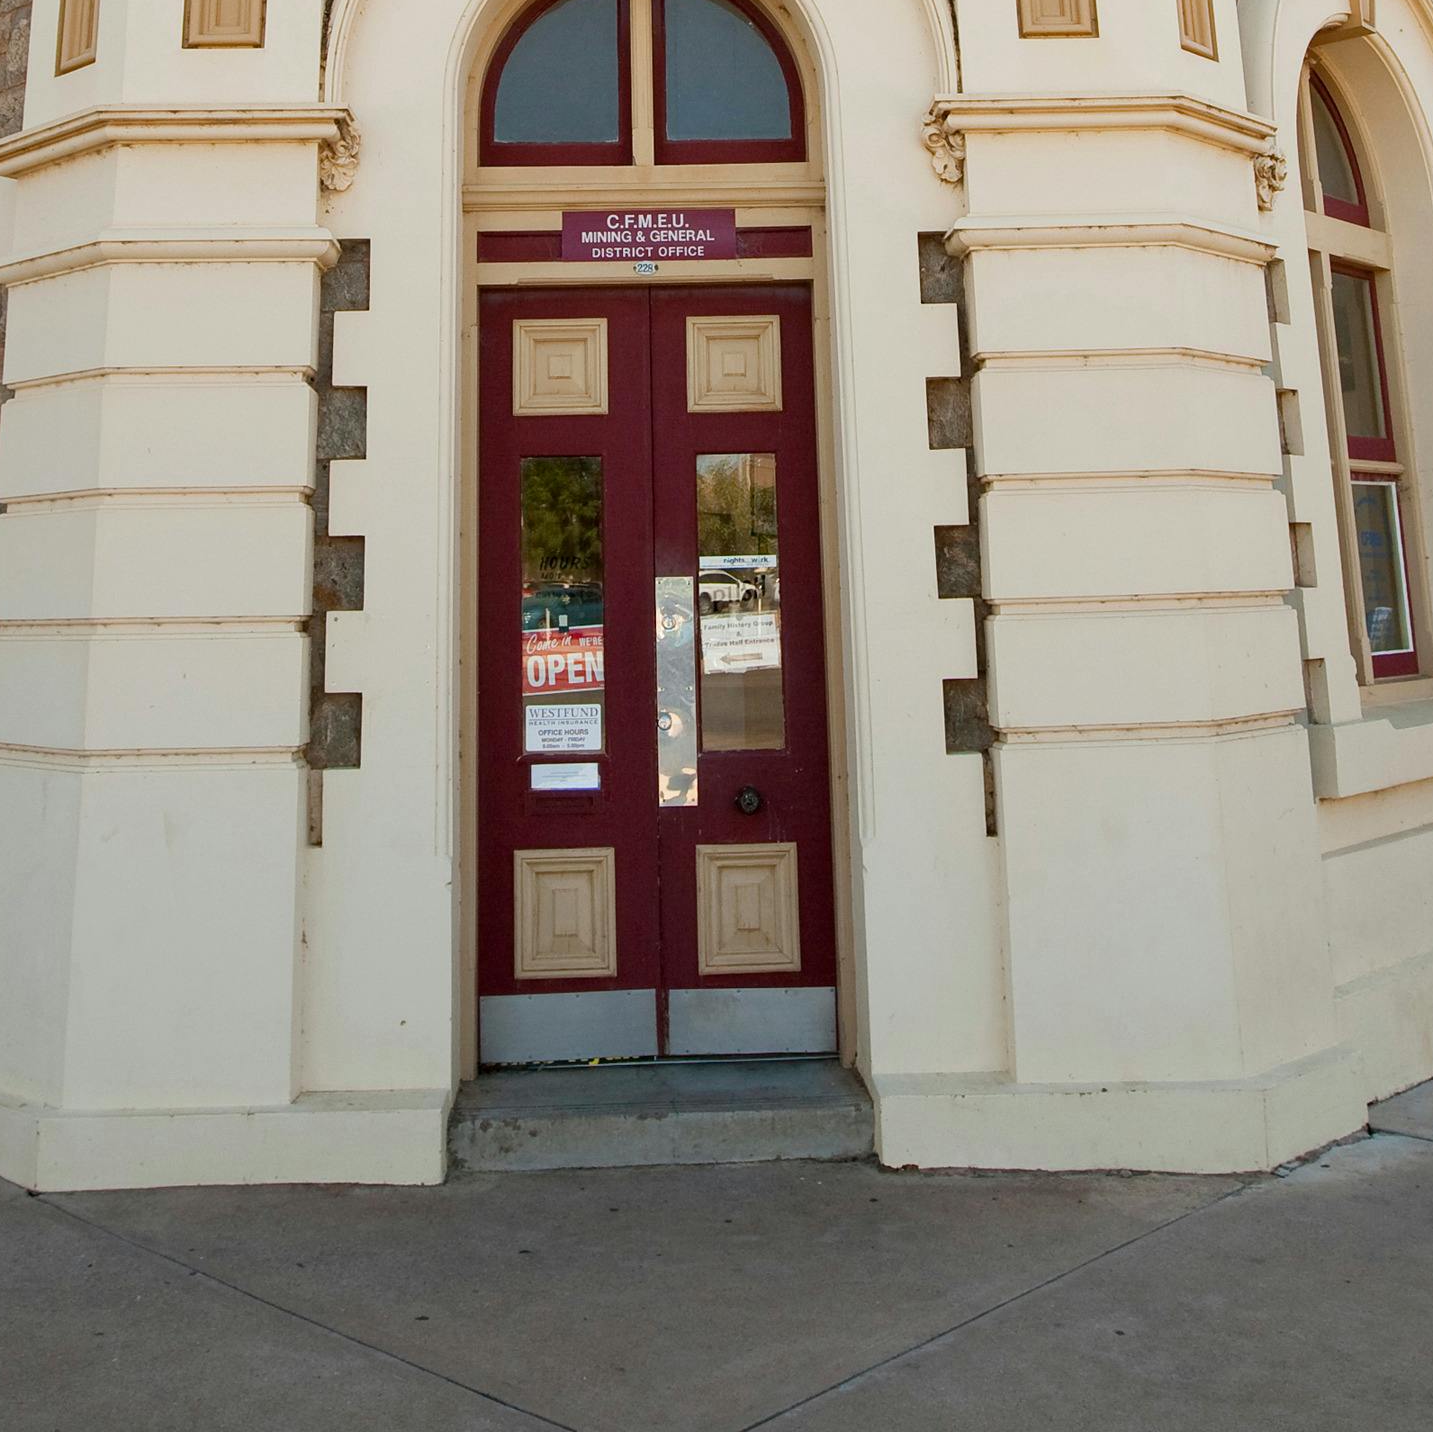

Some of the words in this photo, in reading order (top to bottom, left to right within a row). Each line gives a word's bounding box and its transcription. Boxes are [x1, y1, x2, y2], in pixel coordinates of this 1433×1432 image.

[606, 213, 690, 229] C.F.M.E.U.
[581, 230, 632, 244] MINING
[635, 230, 646, 243] &
[649, 229, 715, 242] GENERAL
[592, 247, 654, 258] DISTRICT
[658, 245, 705, 257] OFFICE
[637, 263, 654, 273] 228
[539, 556, 589, 571] HOURS
[526, 633, 559, 654] Come
[561, 632, 572, 646] in
[527, 651, 605, 687] OPEN
[528, 707, 599, 718] WESTFUND
